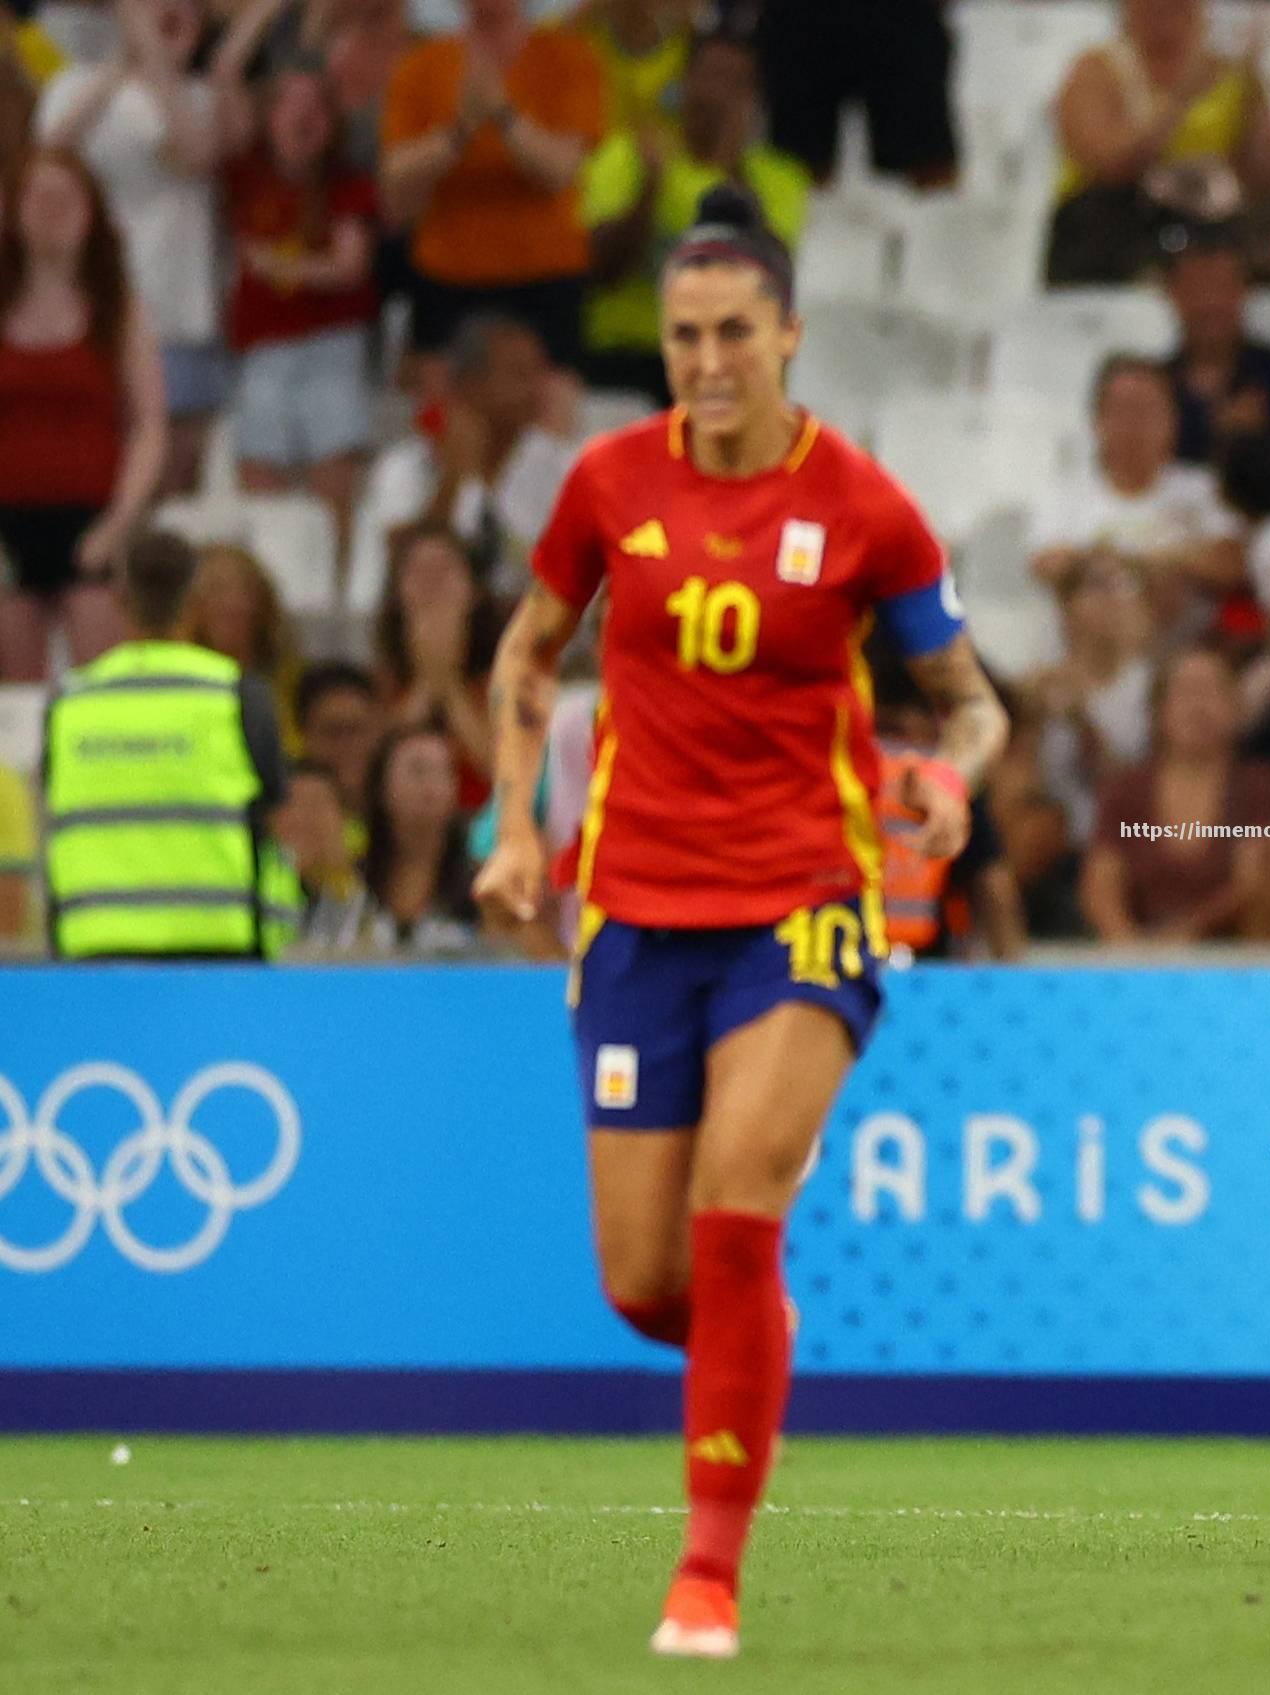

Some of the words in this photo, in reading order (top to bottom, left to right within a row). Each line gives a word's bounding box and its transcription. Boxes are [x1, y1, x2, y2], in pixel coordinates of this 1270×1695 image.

[666, 575, 760, 673] 10
[774, 903, 863, 990] 10
[797, 1112, 1213, 1226] ARiS
